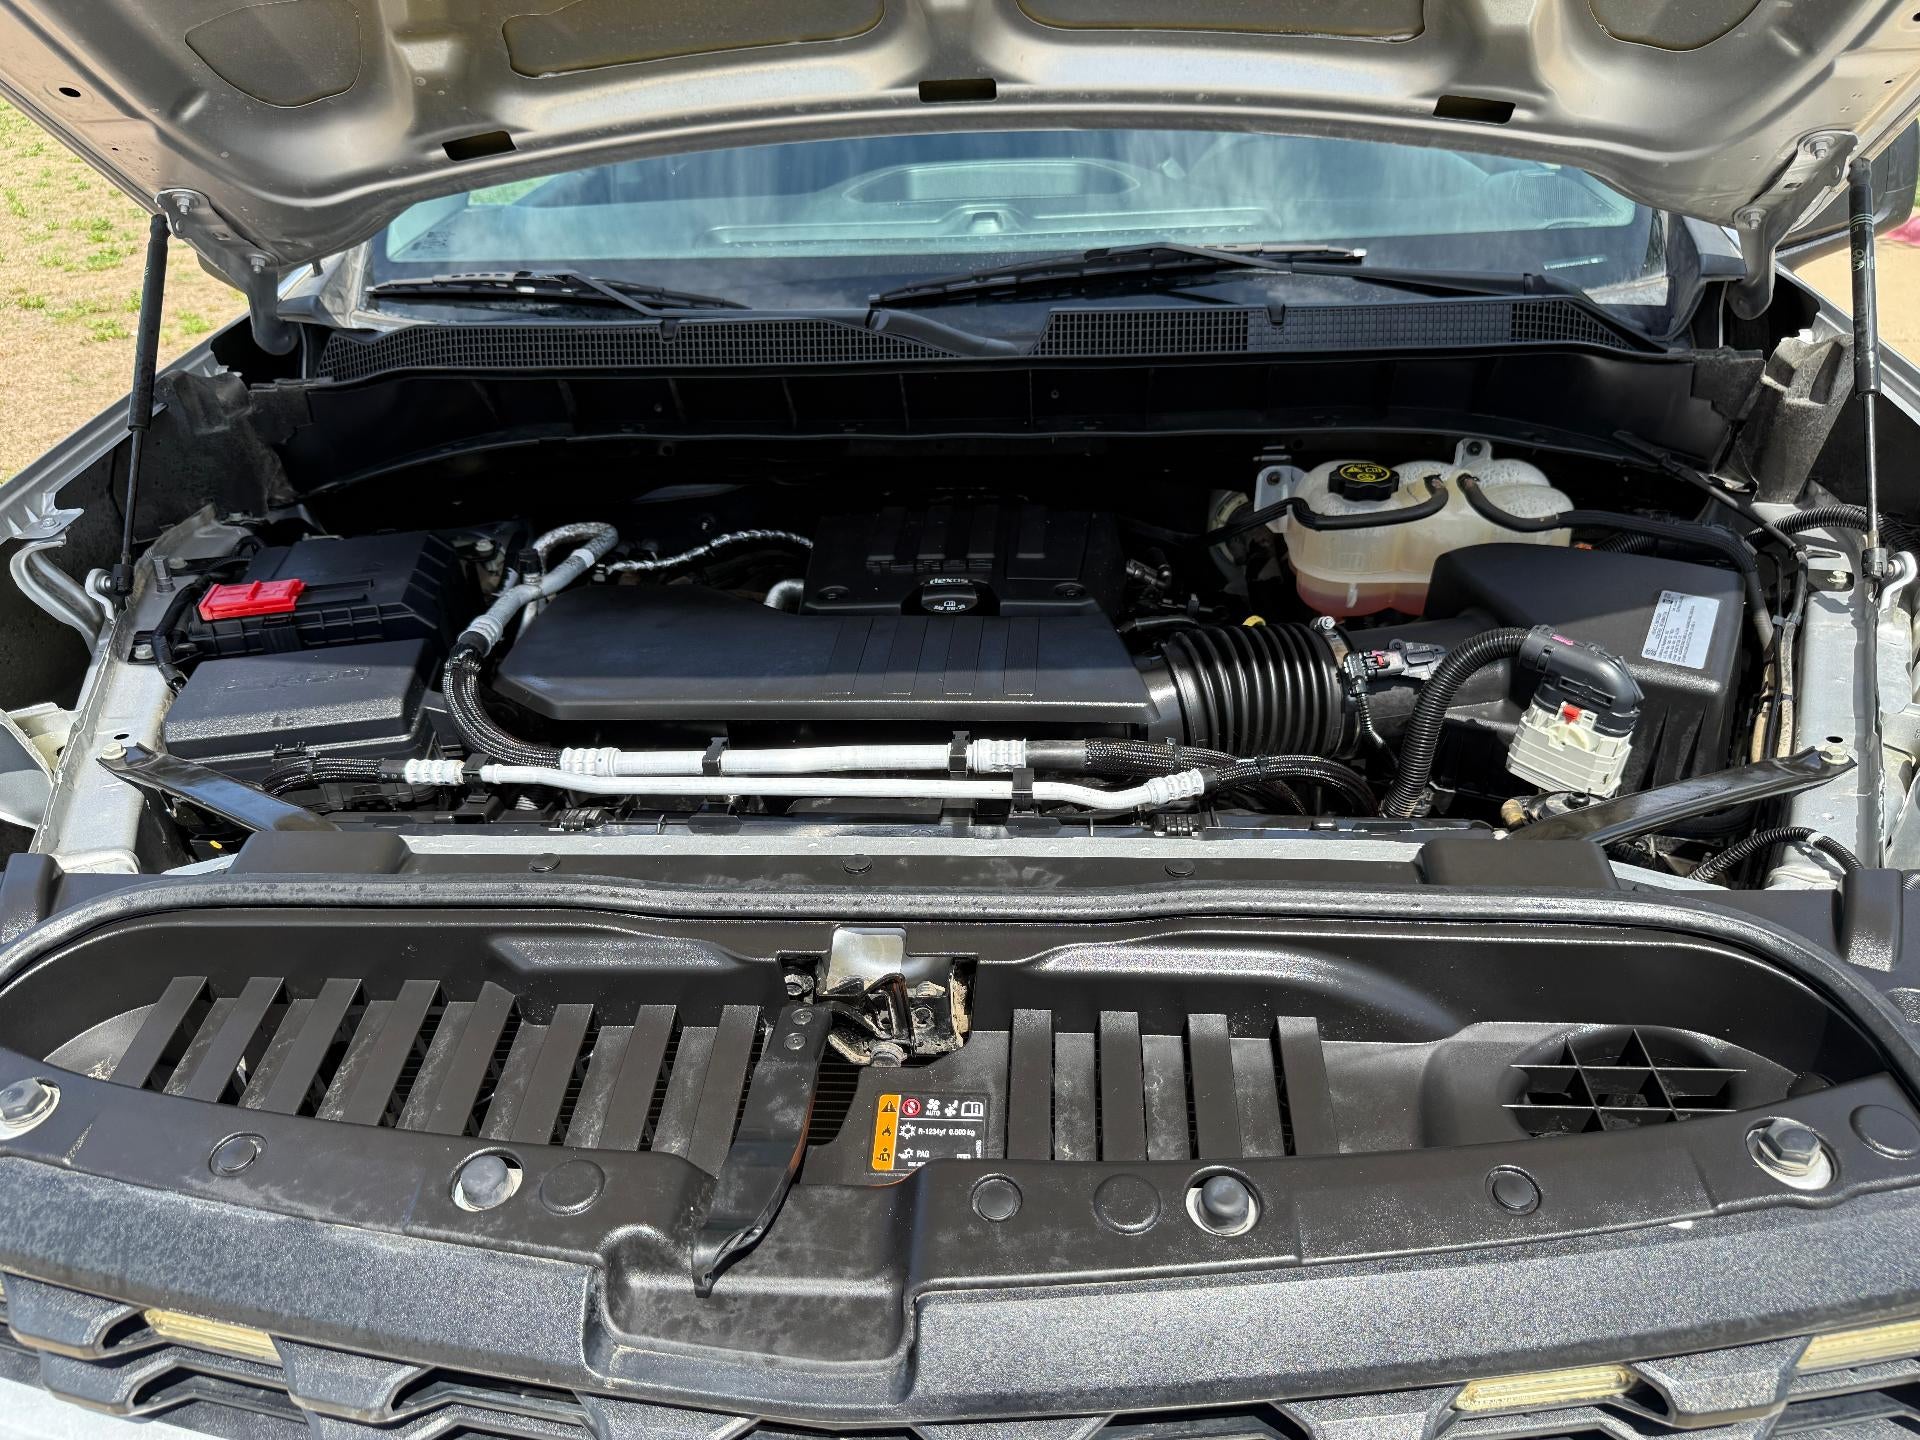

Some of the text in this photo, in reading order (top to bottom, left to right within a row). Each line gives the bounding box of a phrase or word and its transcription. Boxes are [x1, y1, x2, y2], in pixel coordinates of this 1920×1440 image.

[925, 1109, 941, 1117] AUTO
[918, 1127, 947, 1137] R-1234yf
[967, 1128, 976, 1138] kg
[916, 1149, 930, 1158] PAG
